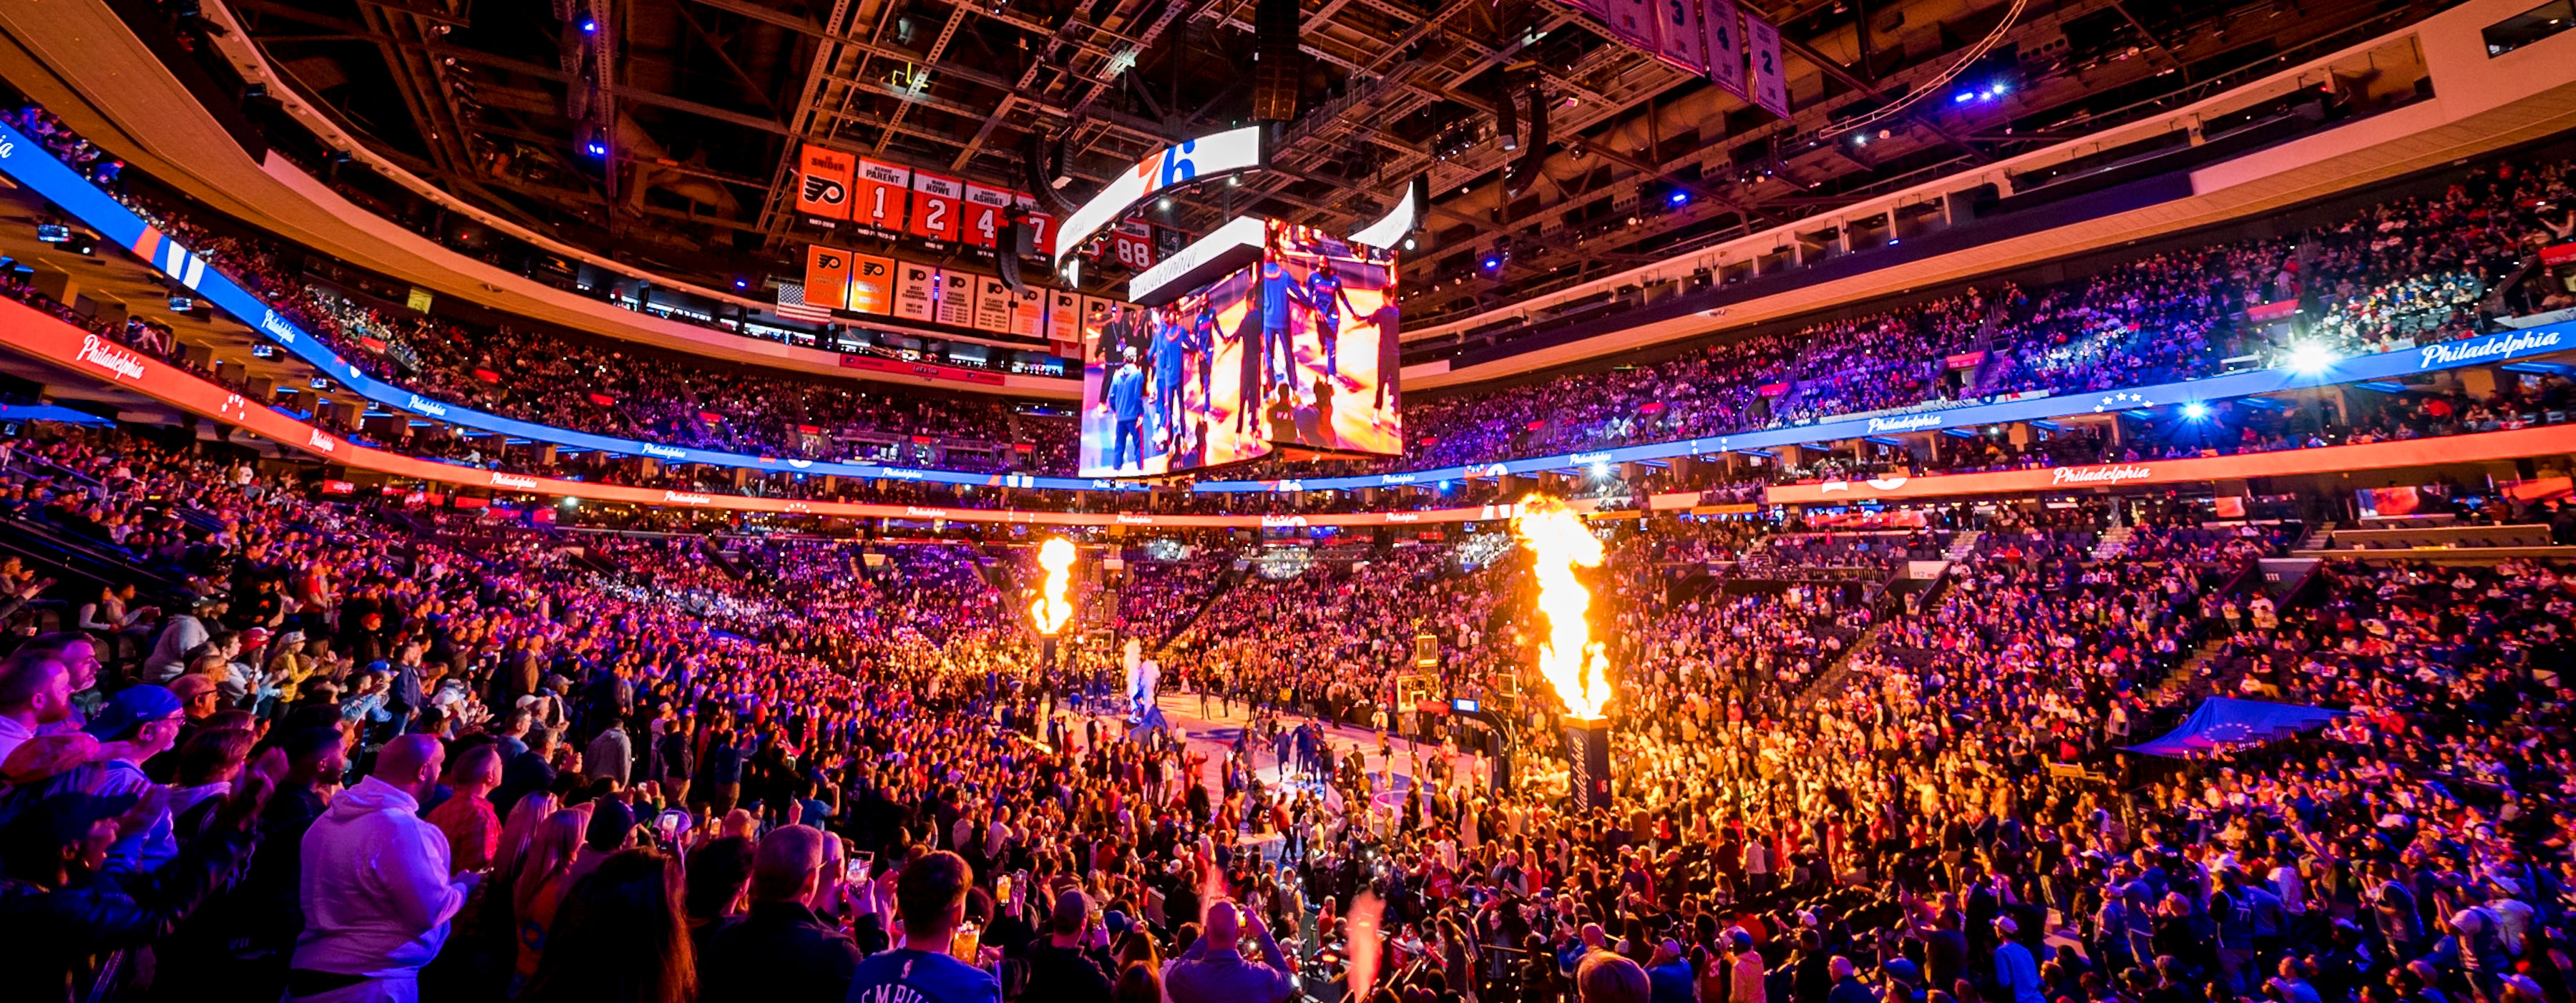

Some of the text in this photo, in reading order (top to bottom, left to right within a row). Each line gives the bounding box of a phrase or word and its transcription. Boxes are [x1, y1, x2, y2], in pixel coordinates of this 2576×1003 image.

[1762, 50, 1774, 76] 2
[811, 157, 844, 171] SNIDER
[866, 170, 900, 184] PARENT
[926, 183, 950, 195] HOWE
[872, 186, 885, 218] 1
[927, 198, 946, 231] 2
[977, 209, 995, 239] 4
[1029, 217, 1045, 244] 7
[1118, 238, 1150, 268] 88
[902, 293, 927, 301] CHAMPIONS
[261, 309, 295, 343] Philadelphia
[76, 333, 146, 381] Philadelphia
[2421, 331, 2561, 368] Philadelphia
[408, 394, 446, 416] Philadelphia
[1868, 415, 1942, 434] Philadelphia
[641, 443, 686, 459] Philadelphia
[1569, 453, 1612, 466] Philadelphia
[489, 471, 537, 490] Philadelphia
[882, 468, 923, 480] Philadelphia
[1382, 474, 1416, 486] Philadelphia
[2052, 465, 2151, 485] Philadelphia
[664, 490, 711, 505] Philadelphia
[906, 506, 947, 519] Philadelphia
[1115, 514, 1153, 525] Philadelphia
[1385, 512, 1419, 523] Philadelphia
[1571, 736, 1591, 811] ladelphia
[1596, 780, 1608, 794] 76
